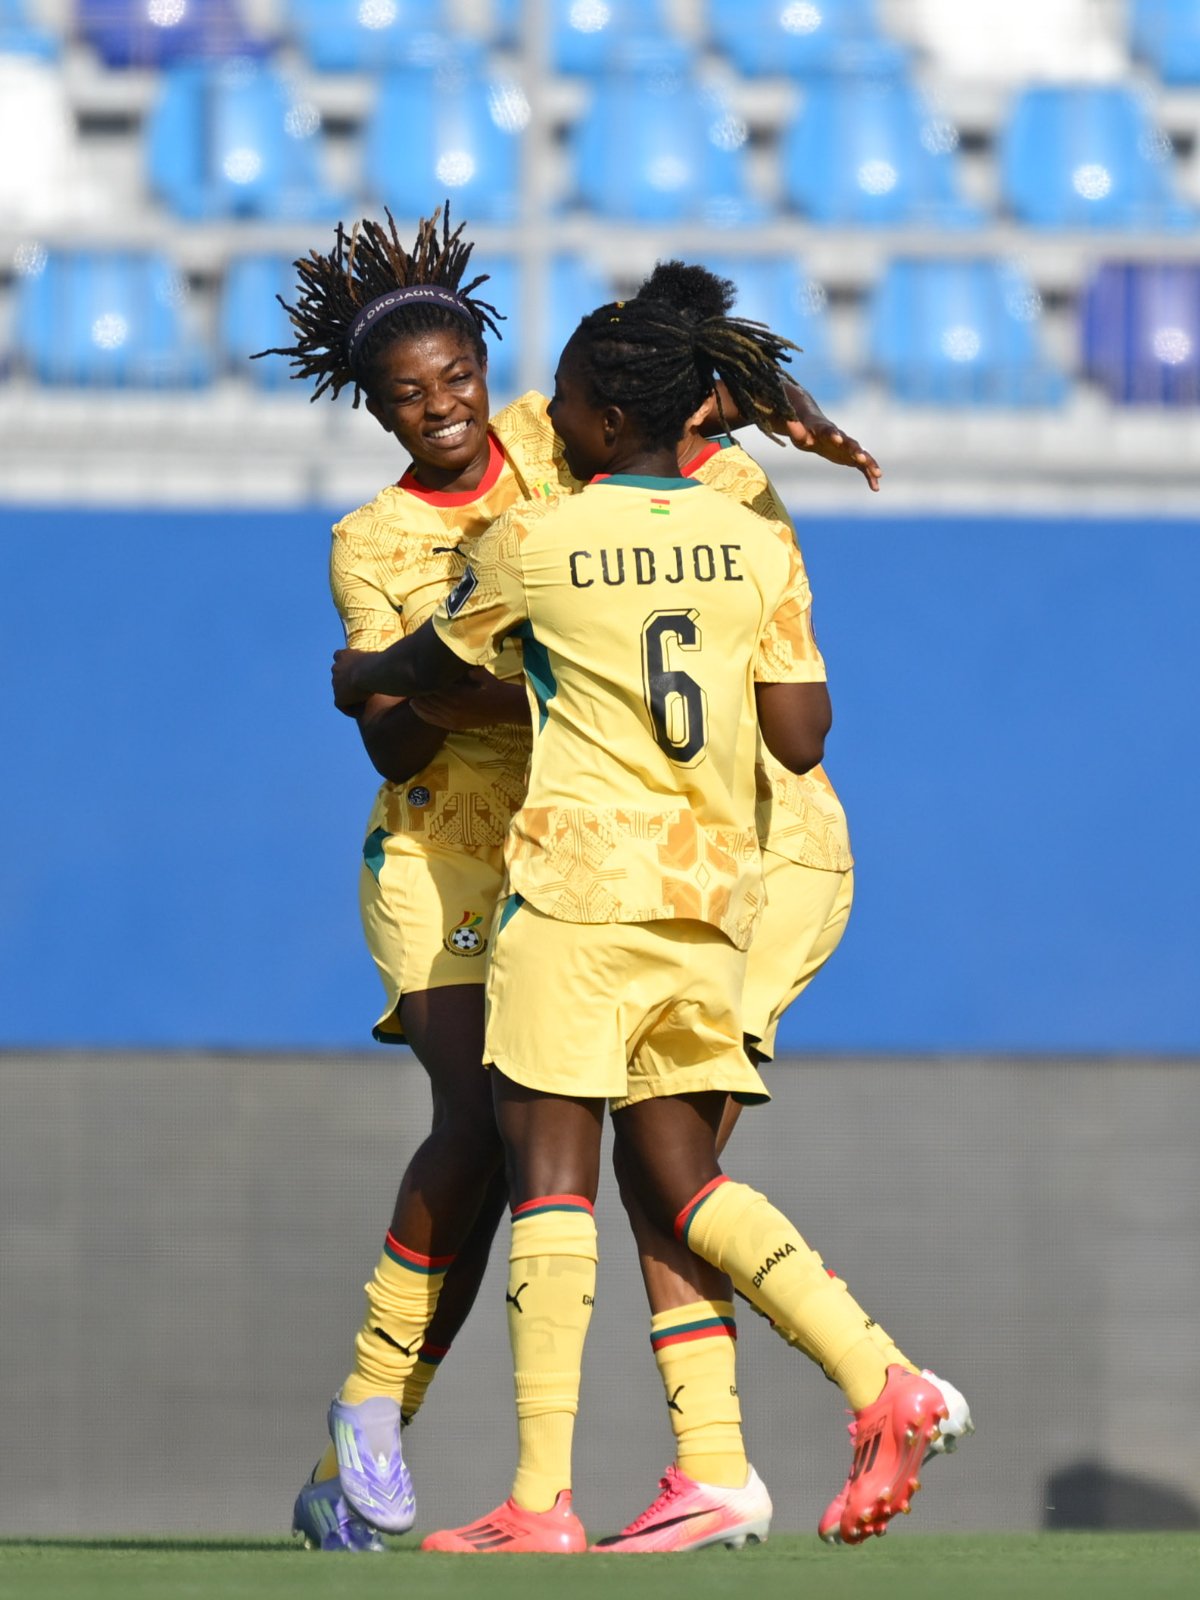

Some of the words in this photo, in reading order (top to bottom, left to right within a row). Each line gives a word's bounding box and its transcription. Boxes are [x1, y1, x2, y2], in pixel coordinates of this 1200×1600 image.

[569, 544, 744, 589] CUDJOE
[640, 608, 709, 769] 6
[752, 1243, 797, 1289] GHANA
